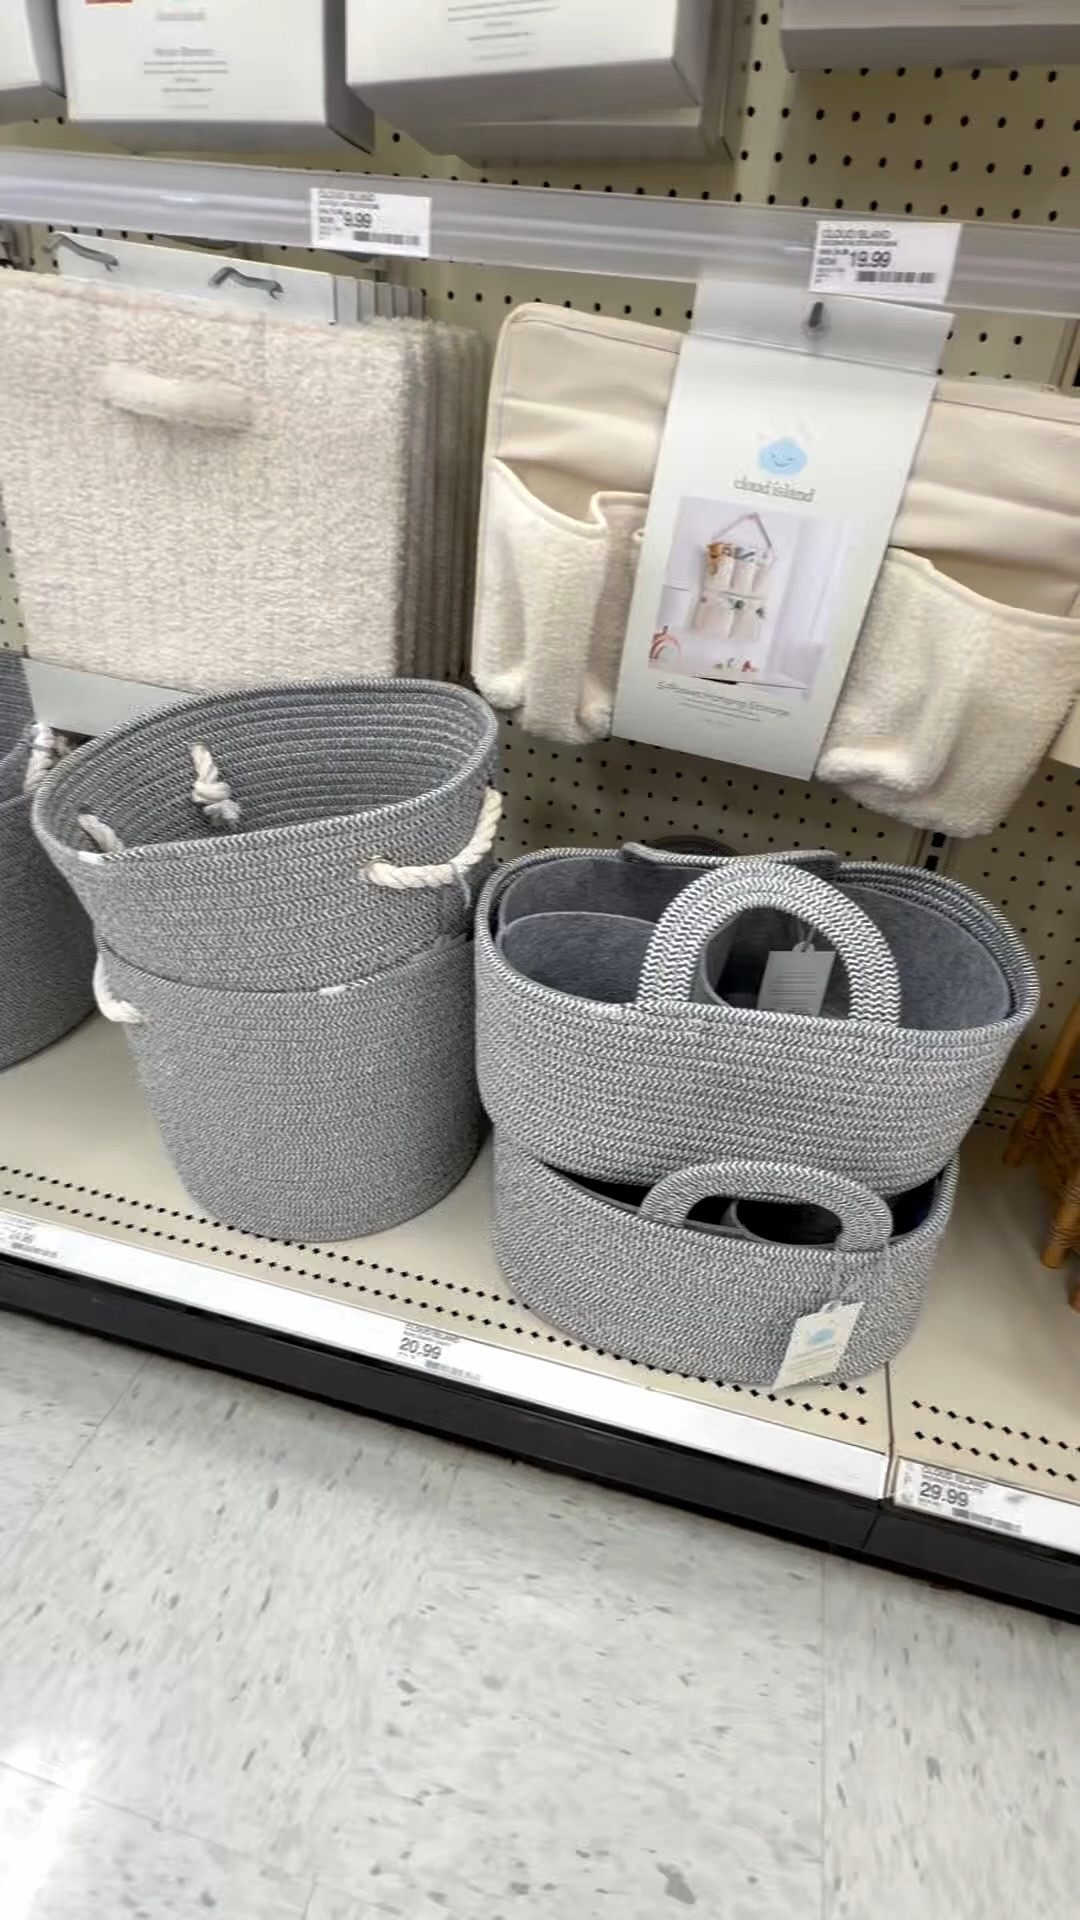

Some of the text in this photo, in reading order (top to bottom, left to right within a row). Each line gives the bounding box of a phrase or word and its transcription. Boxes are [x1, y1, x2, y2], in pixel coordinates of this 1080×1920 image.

[343, 211, 372, 229] 9.99
[849, 250, 892, 268] 19.99
[398, 1336, 442, 1360] 20.99
[919, 1481, 969, 1507] 29.99
